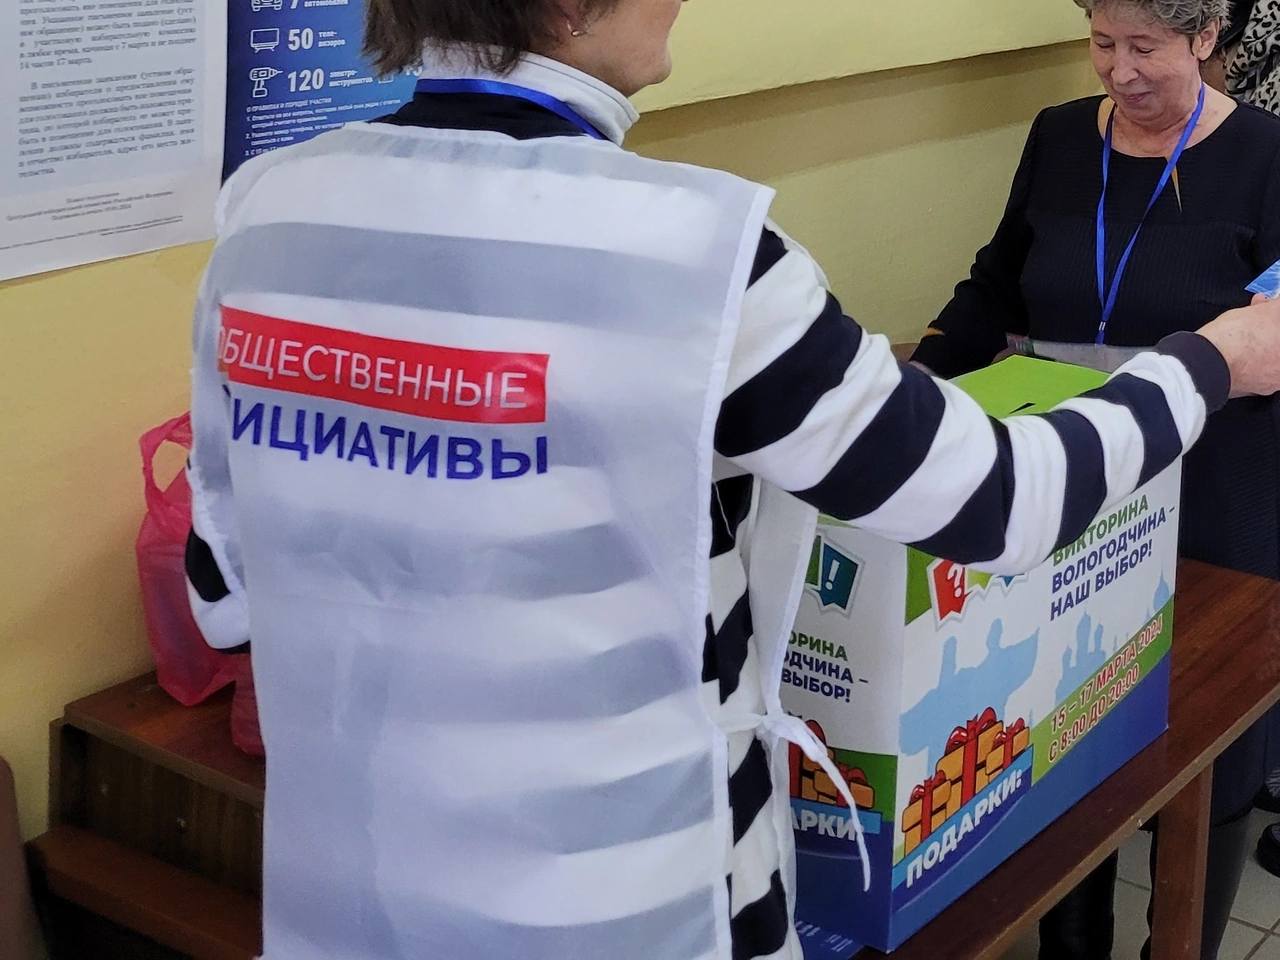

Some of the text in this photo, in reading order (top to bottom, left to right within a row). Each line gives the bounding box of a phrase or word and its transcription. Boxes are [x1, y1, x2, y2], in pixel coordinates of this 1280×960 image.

[287, 68, 325, 92] 120
[288, 27, 314, 51] 50
[222, 384, 548, 480] ИЦИАТИВЫ
[1050, 539, 1153, 621] НАШ ВЫБОР!
[1052, 507, 1166, 594] ВОЛОГОДЧИНА
[782, 668, 851, 703] ВЫБОР!
[1051, 704, 1067, 734] 15
[1080, 680, 1094, 707] 17
[1095, 642, 1135, 695] МАРТА
[1138, 614, 1163, 655] 2024
[1060, 713, 1086, 752] 8:00
[1088, 695, 1107, 731] ДО
[1108, 663, 1140, 708] 20:00
[905, 771, 1024, 888] ПОДАРКИ:
